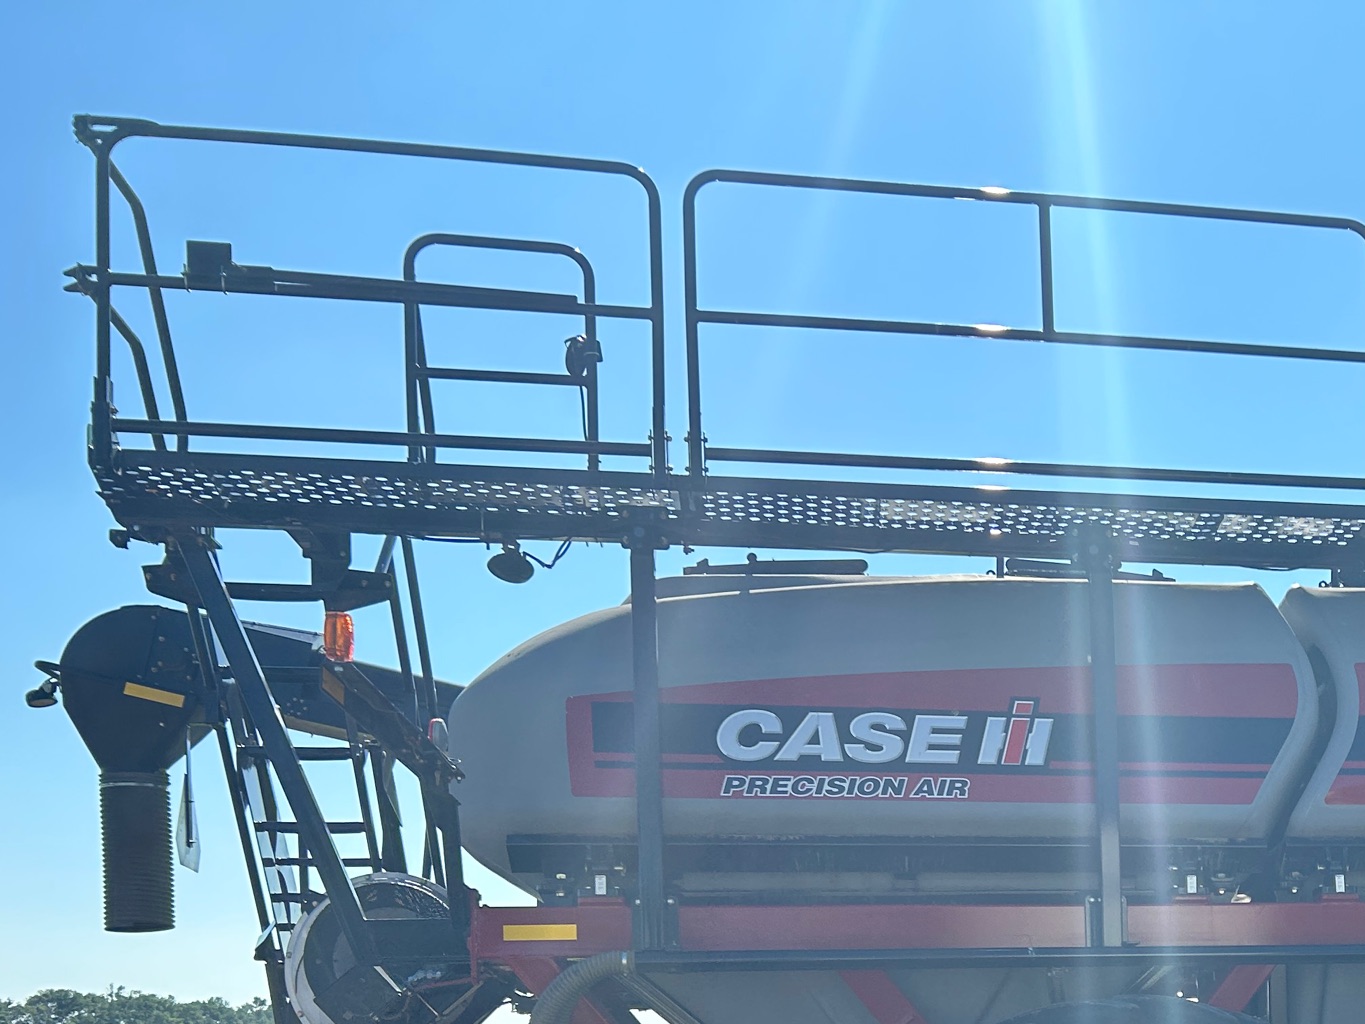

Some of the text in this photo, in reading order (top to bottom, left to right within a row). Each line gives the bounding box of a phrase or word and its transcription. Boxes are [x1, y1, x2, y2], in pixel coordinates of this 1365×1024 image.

[716, 709, 968, 764] CASE
[720, 775, 970, 798] PRECISION AIR
